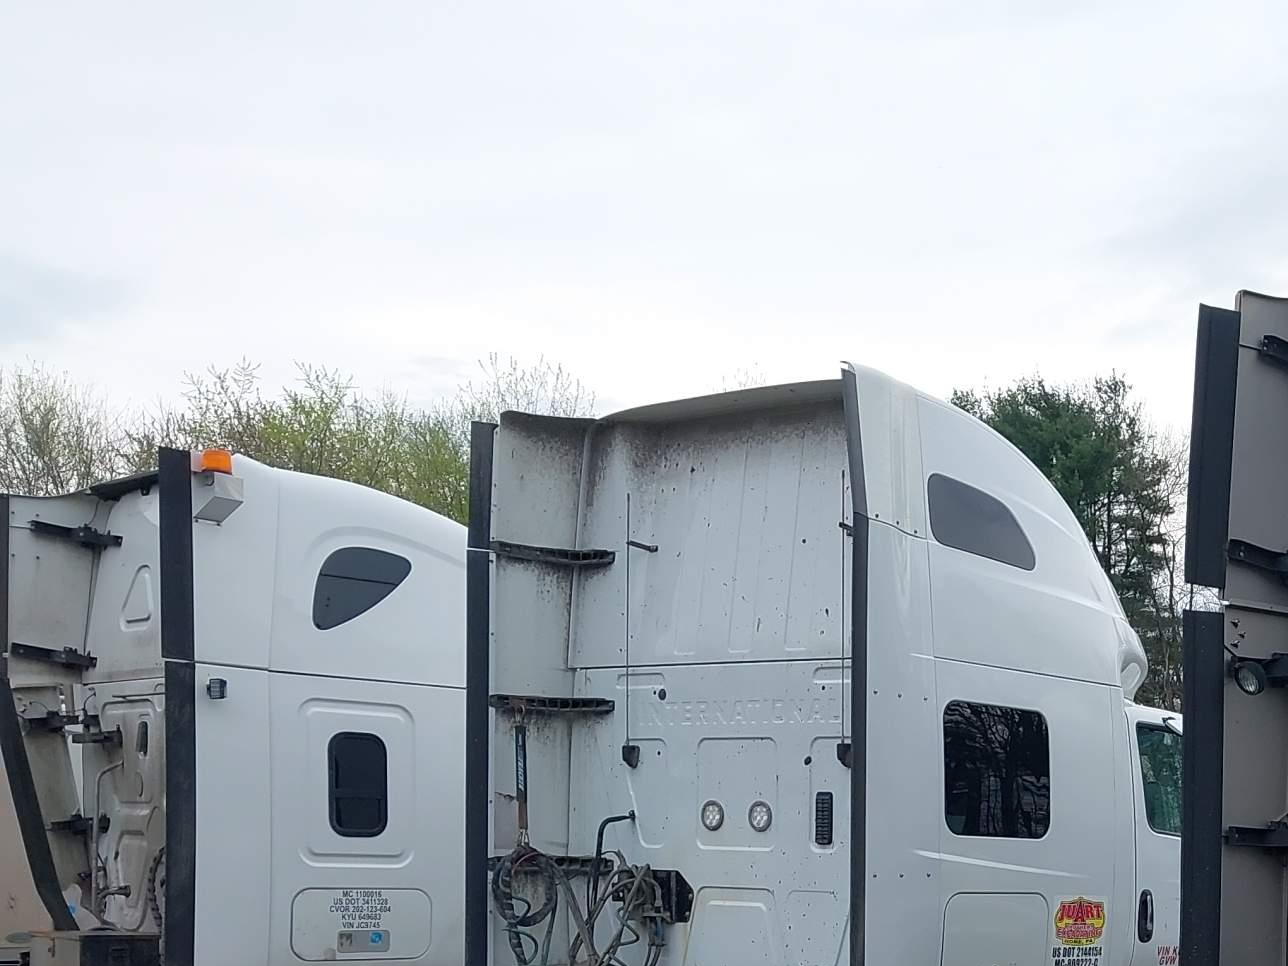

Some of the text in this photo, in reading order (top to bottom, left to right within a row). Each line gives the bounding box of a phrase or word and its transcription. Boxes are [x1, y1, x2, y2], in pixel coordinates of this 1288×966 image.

[637, 698, 841, 726] INTERNATIONAL
[342, 890, 353, 898] MC
[329, 905, 351, 913] CVOR
[1058, 902, 1103, 922] JUART
[341, 913, 356, 921] KYU
[342, 921, 354, 929] VIN
[1052, 946, 1103, 957] US DOT 2144154
[1157, 945, 1170, 957] VIN
[1159, 956, 1177, 966] GVW
